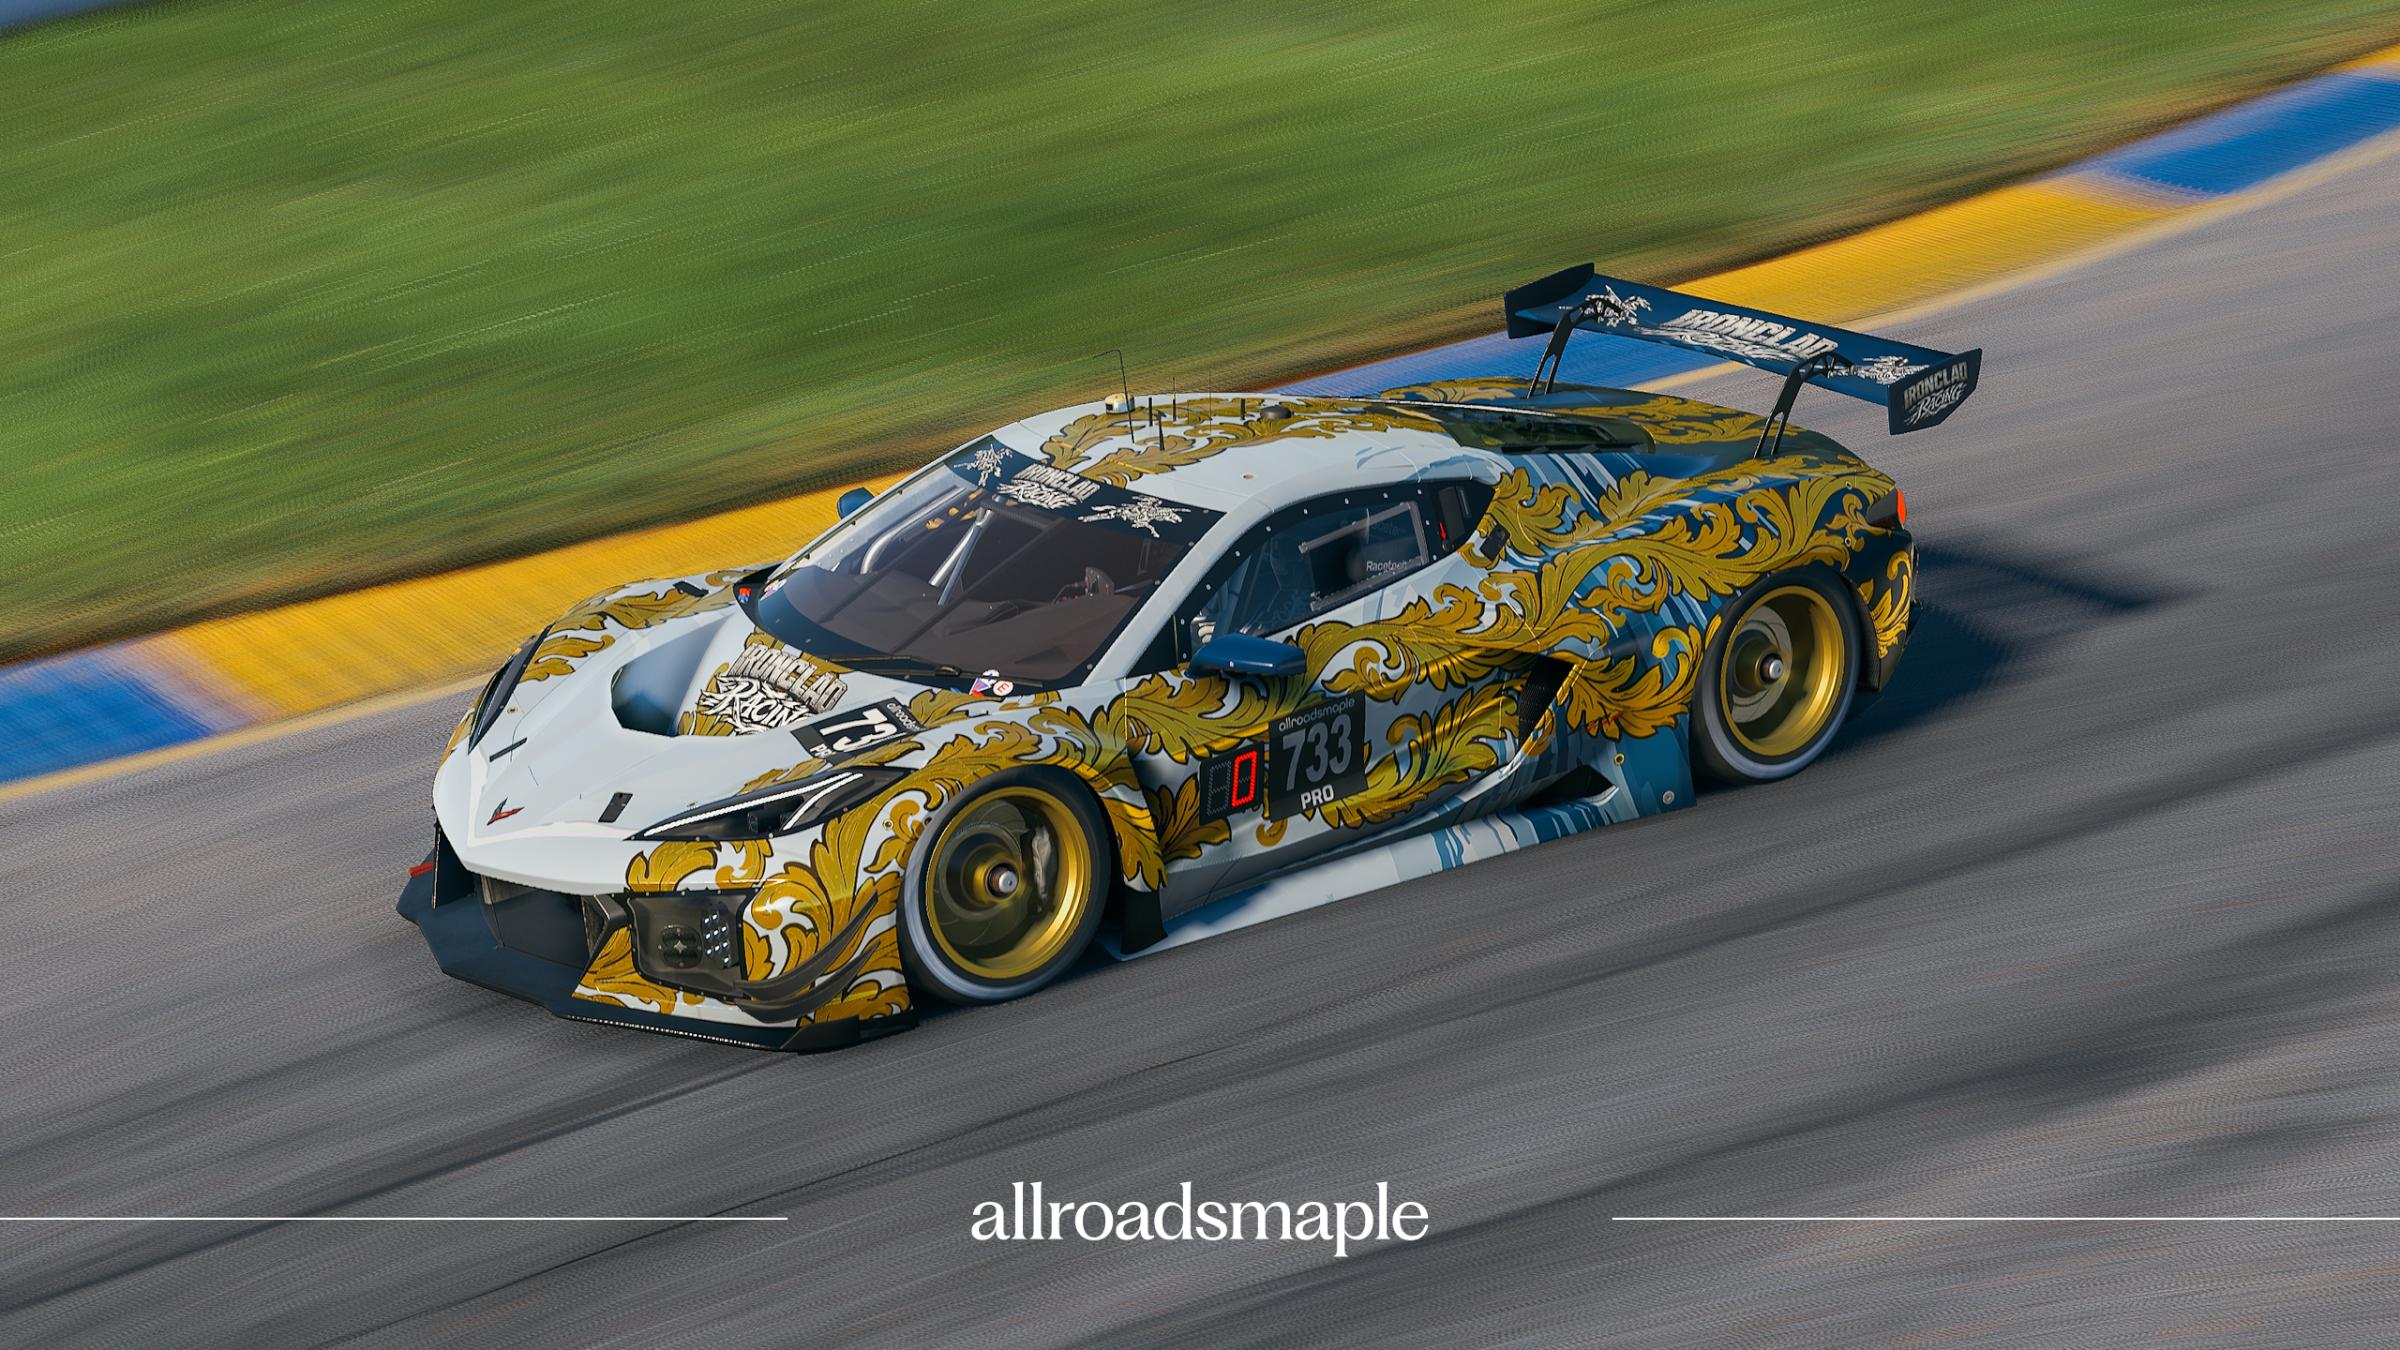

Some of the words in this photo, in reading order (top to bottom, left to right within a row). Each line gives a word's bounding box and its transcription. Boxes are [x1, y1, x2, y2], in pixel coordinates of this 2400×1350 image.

[1660, 308, 1839, 359] IRONCLAD
[1903, 361, 1969, 411] IRONCLAD
[1012, 463, 1101, 503] IRONCLAD
[726, 642, 848, 715] IRONCLAD
[1281, 714, 1353, 792] 733
[1231, 750, 1258, 808] 0
[1300, 783, 1335, 810] PRO
